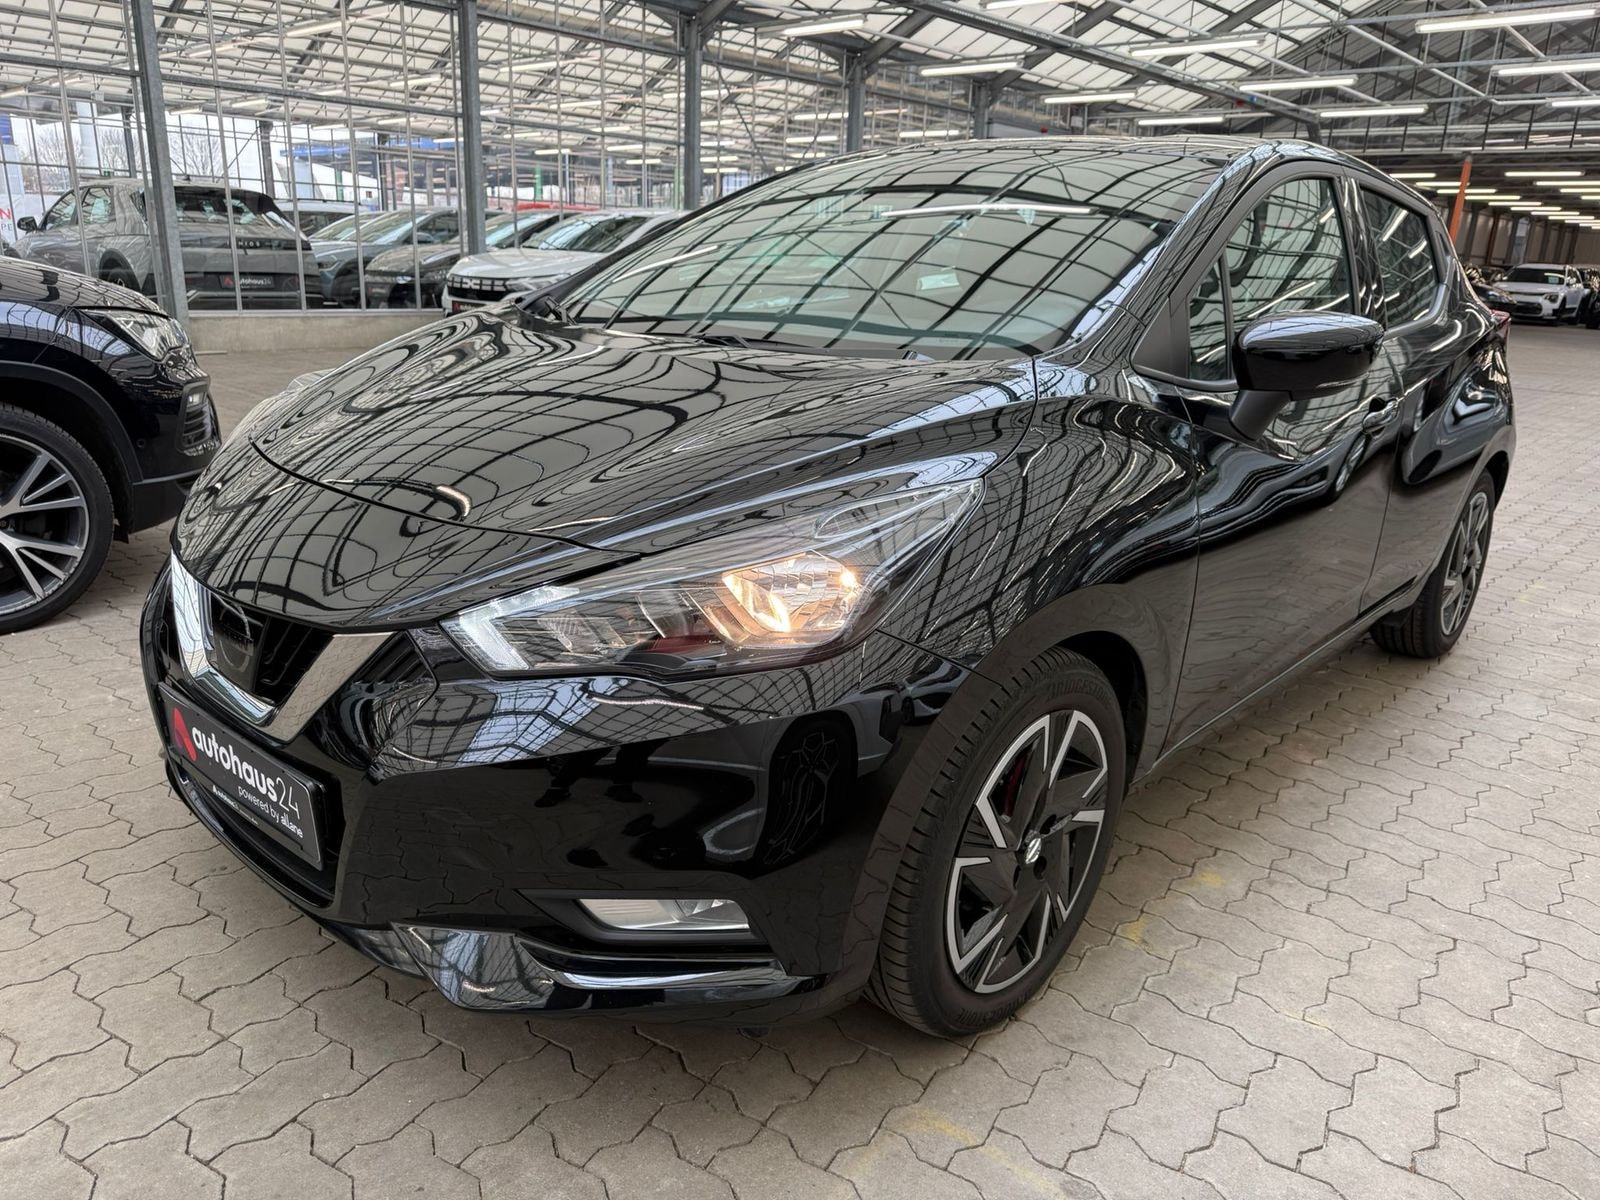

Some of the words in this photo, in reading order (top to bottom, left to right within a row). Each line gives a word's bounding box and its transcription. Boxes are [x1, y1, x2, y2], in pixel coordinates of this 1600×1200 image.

[191, 726, 300, 820] autohaus24
[238, 785, 270, 814] powered
[269, 805, 280, 823] by
